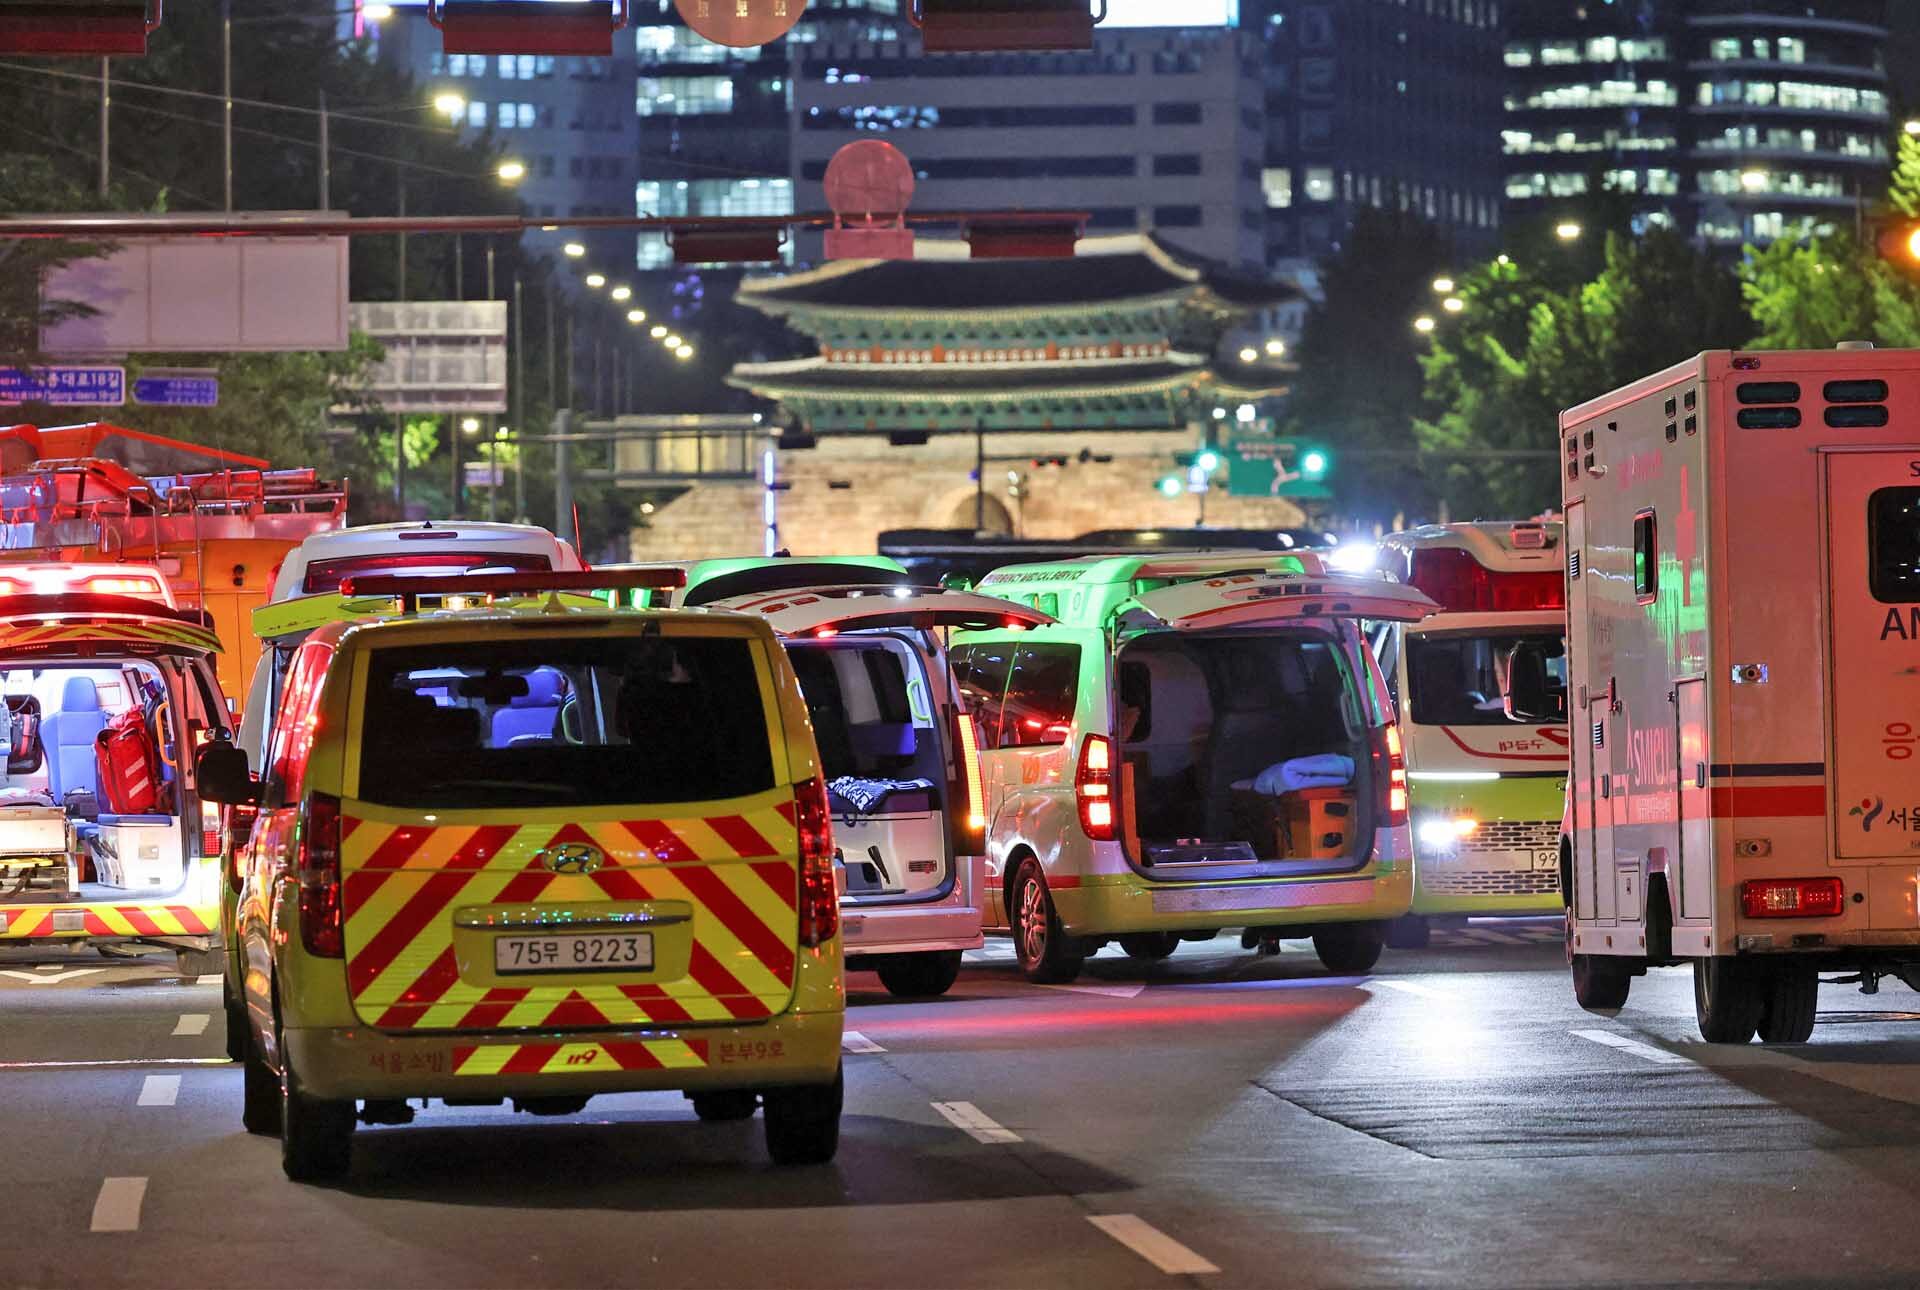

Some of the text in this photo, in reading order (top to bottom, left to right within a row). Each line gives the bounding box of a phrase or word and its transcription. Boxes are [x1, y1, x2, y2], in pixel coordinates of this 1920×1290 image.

[1882, 722, 1920, 760] 응
[509, 938, 638, 965] 75무 8223
[566, 1048, 598, 1066] 119
